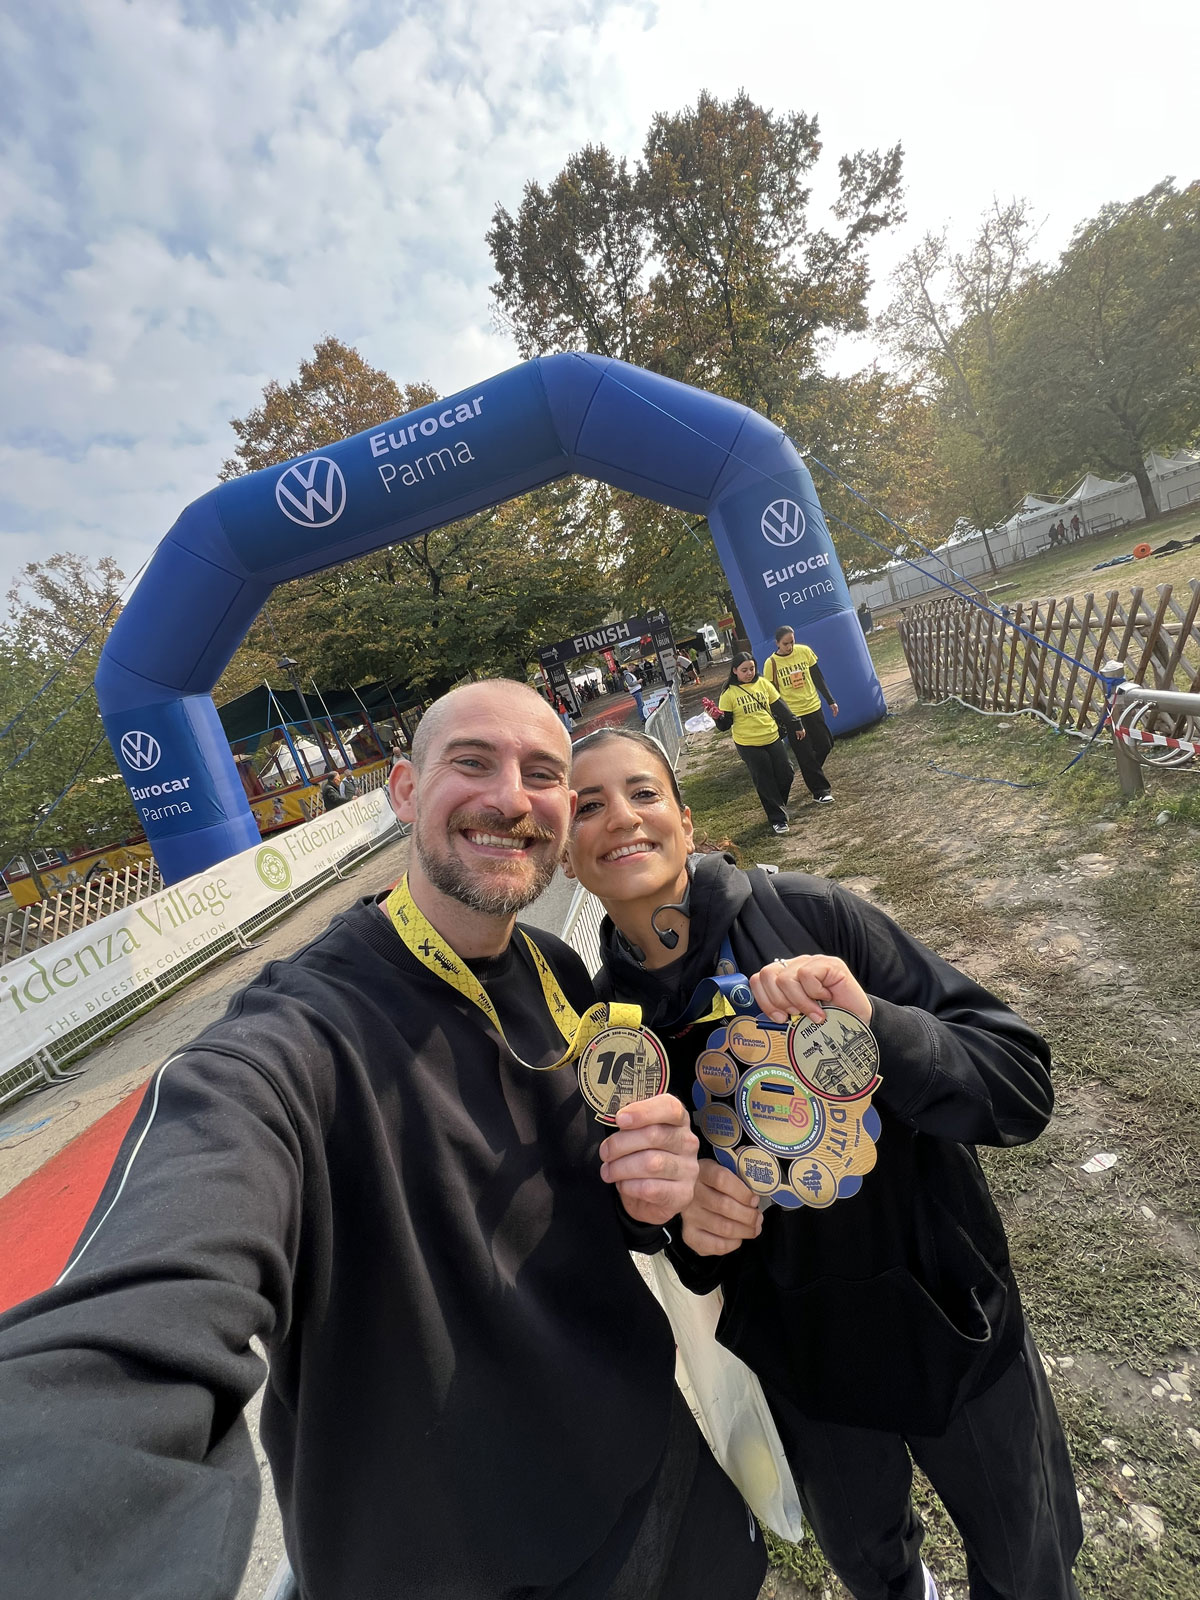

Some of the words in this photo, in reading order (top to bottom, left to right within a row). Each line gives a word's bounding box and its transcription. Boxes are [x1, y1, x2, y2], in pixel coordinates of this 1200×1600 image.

[369, 395, 484, 457] Eurocar
[377, 440, 475, 493] Parma
[762, 552, 830, 589] Eurocar
[778, 579, 835, 610] Parma
[573, 622, 631, 653] FINISH
[782, 671, 806, 686] BELS
[130, 776, 190, 801] Eurocar
[142, 801, 192, 822] Parma
[283, 819, 345, 861] Fidenza
[341, 799, 382, 829] Village
[0, 927, 141, 1014] idenza
[135, 878, 232, 937] Village
[44, 1010, 81, 1036] THE
[85, 967, 153, 1013] BICESTER
[156, 922, 227, 969] COLLECTION
